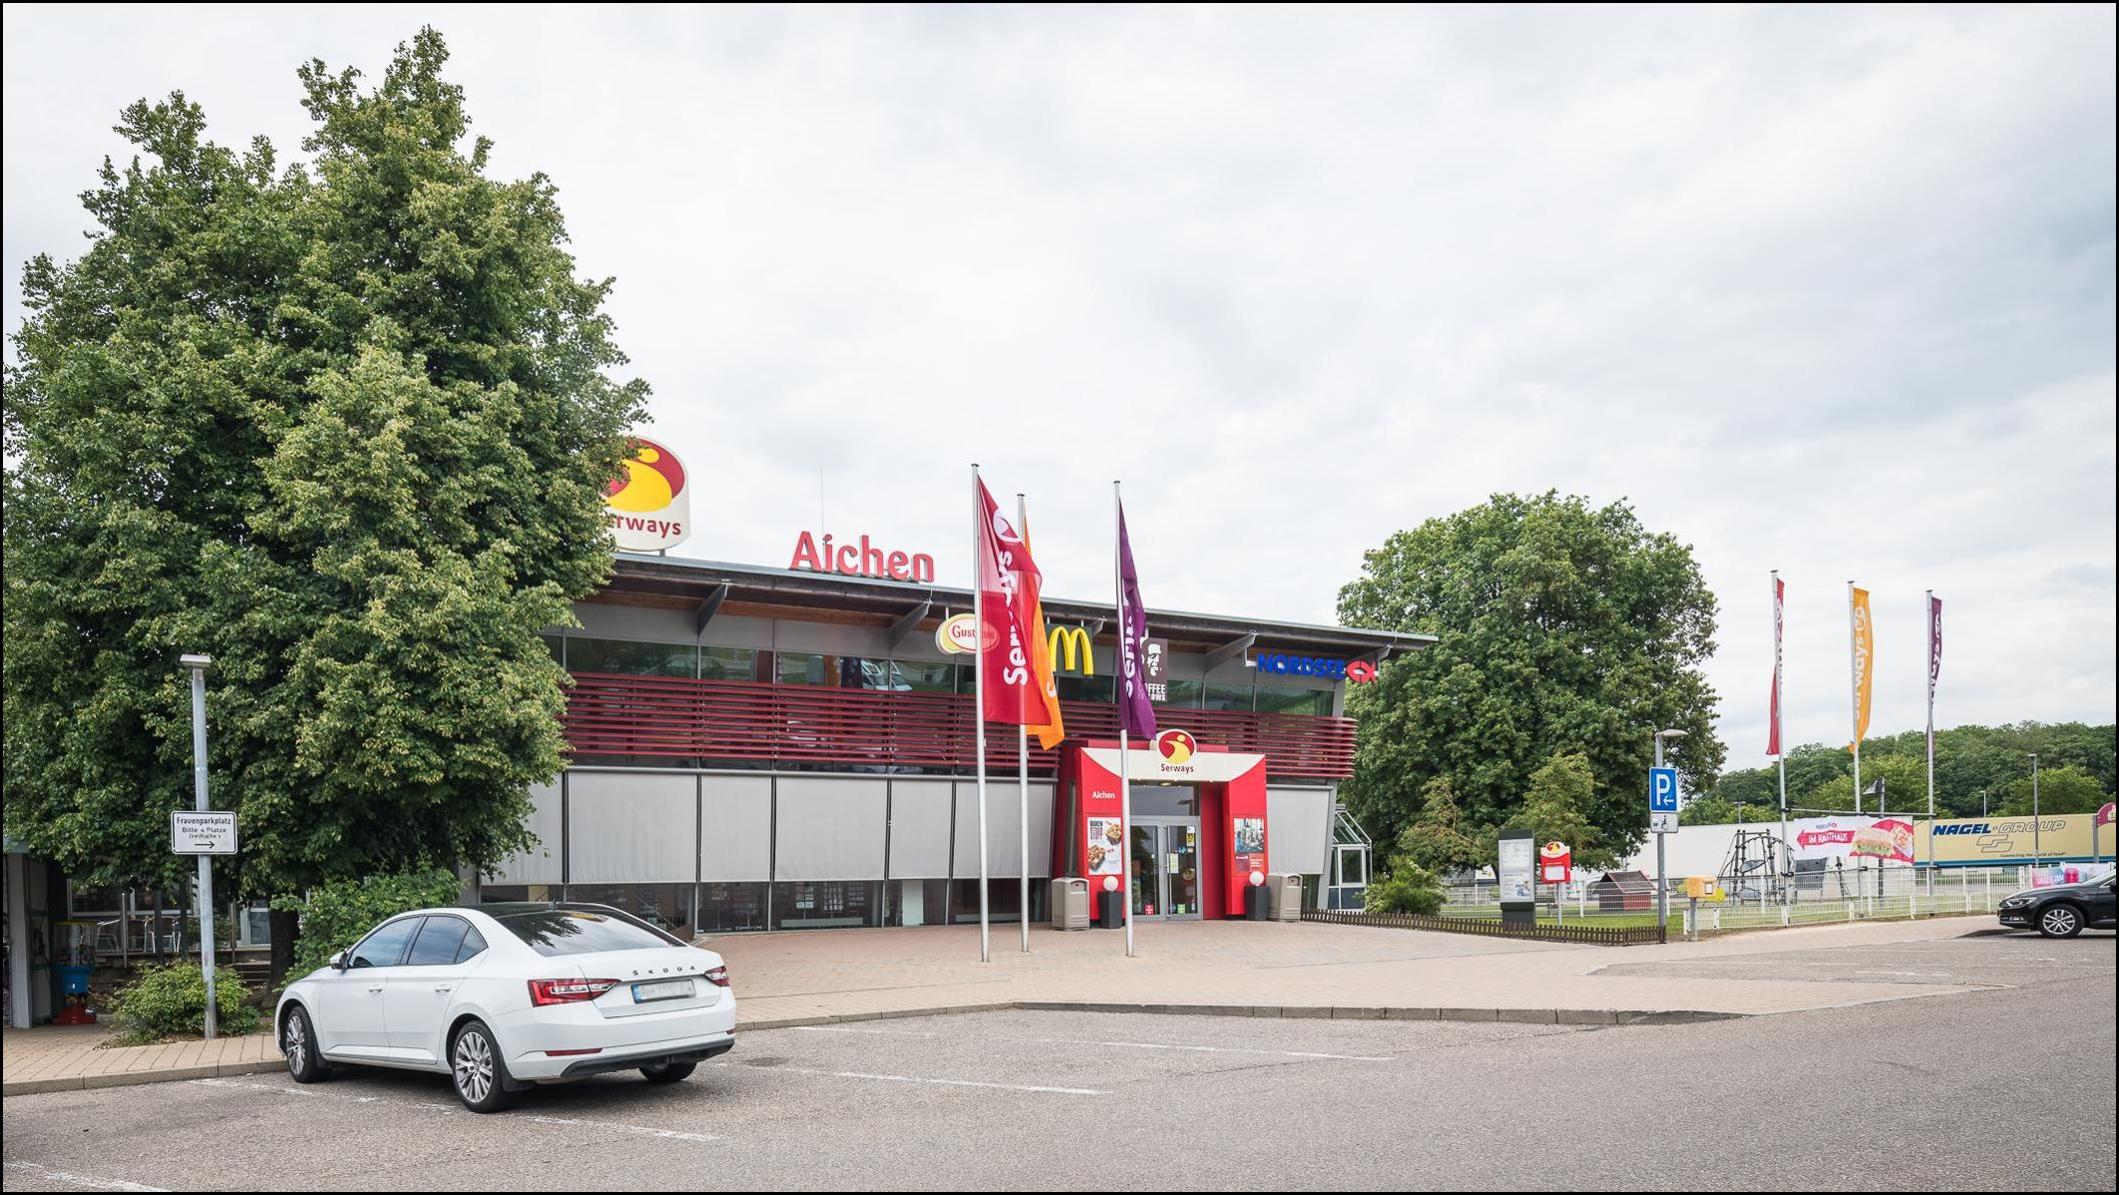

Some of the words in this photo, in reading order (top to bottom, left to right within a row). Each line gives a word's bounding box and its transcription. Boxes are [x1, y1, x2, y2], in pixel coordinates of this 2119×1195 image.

[610, 514, 682, 539] rways
[789, 530, 934, 583] Aichen
[1256, 653, 1345, 679] NORDSEE
[1160, 763, 1194, 774] Serways
[1092, 790, 1116, 799] Aichen
[1656, 774, 1670, 806] P
[176, 817, 231, 825] Frauenparkplatz
